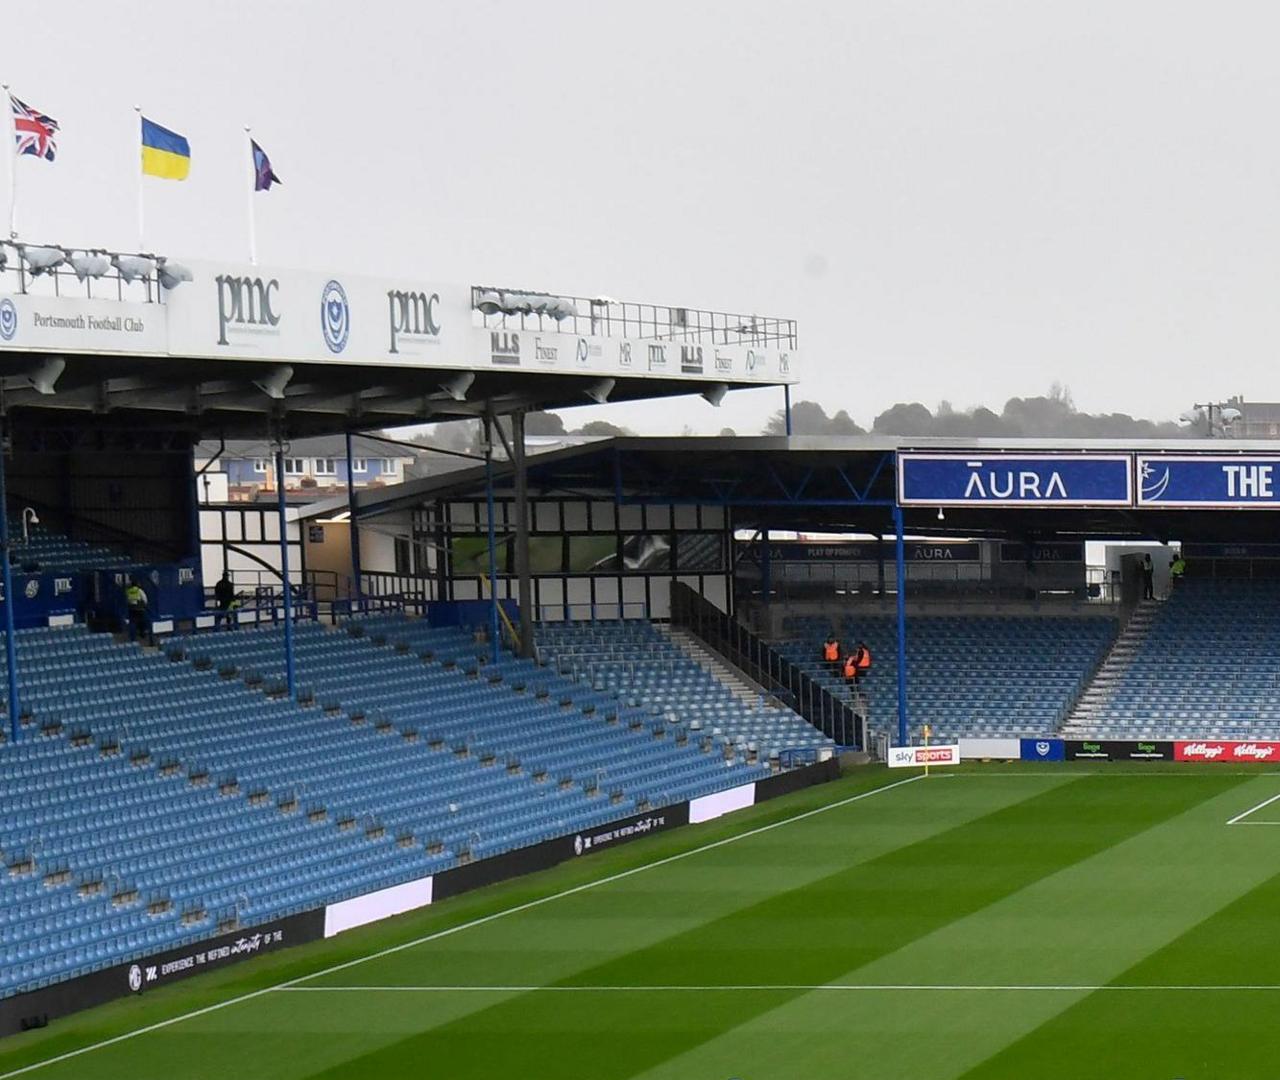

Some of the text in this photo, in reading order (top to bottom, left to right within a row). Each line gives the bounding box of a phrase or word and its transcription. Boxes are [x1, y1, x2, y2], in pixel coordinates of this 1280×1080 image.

[34, 312, 144, 332] Portsmouth Football Club
[215, 275, 281, 345] pmc
[386, 290, 441, 354] pmc
[1222, 465, 1273, 497] THE
[896, 748, 952, 763] sky sports
[162, 957, 195, 975] EXPERIENCE
[196, 954, 206, 965] THE
[207, 946, 230, 961] REFINED
[273, 930, 283, 942] THE
